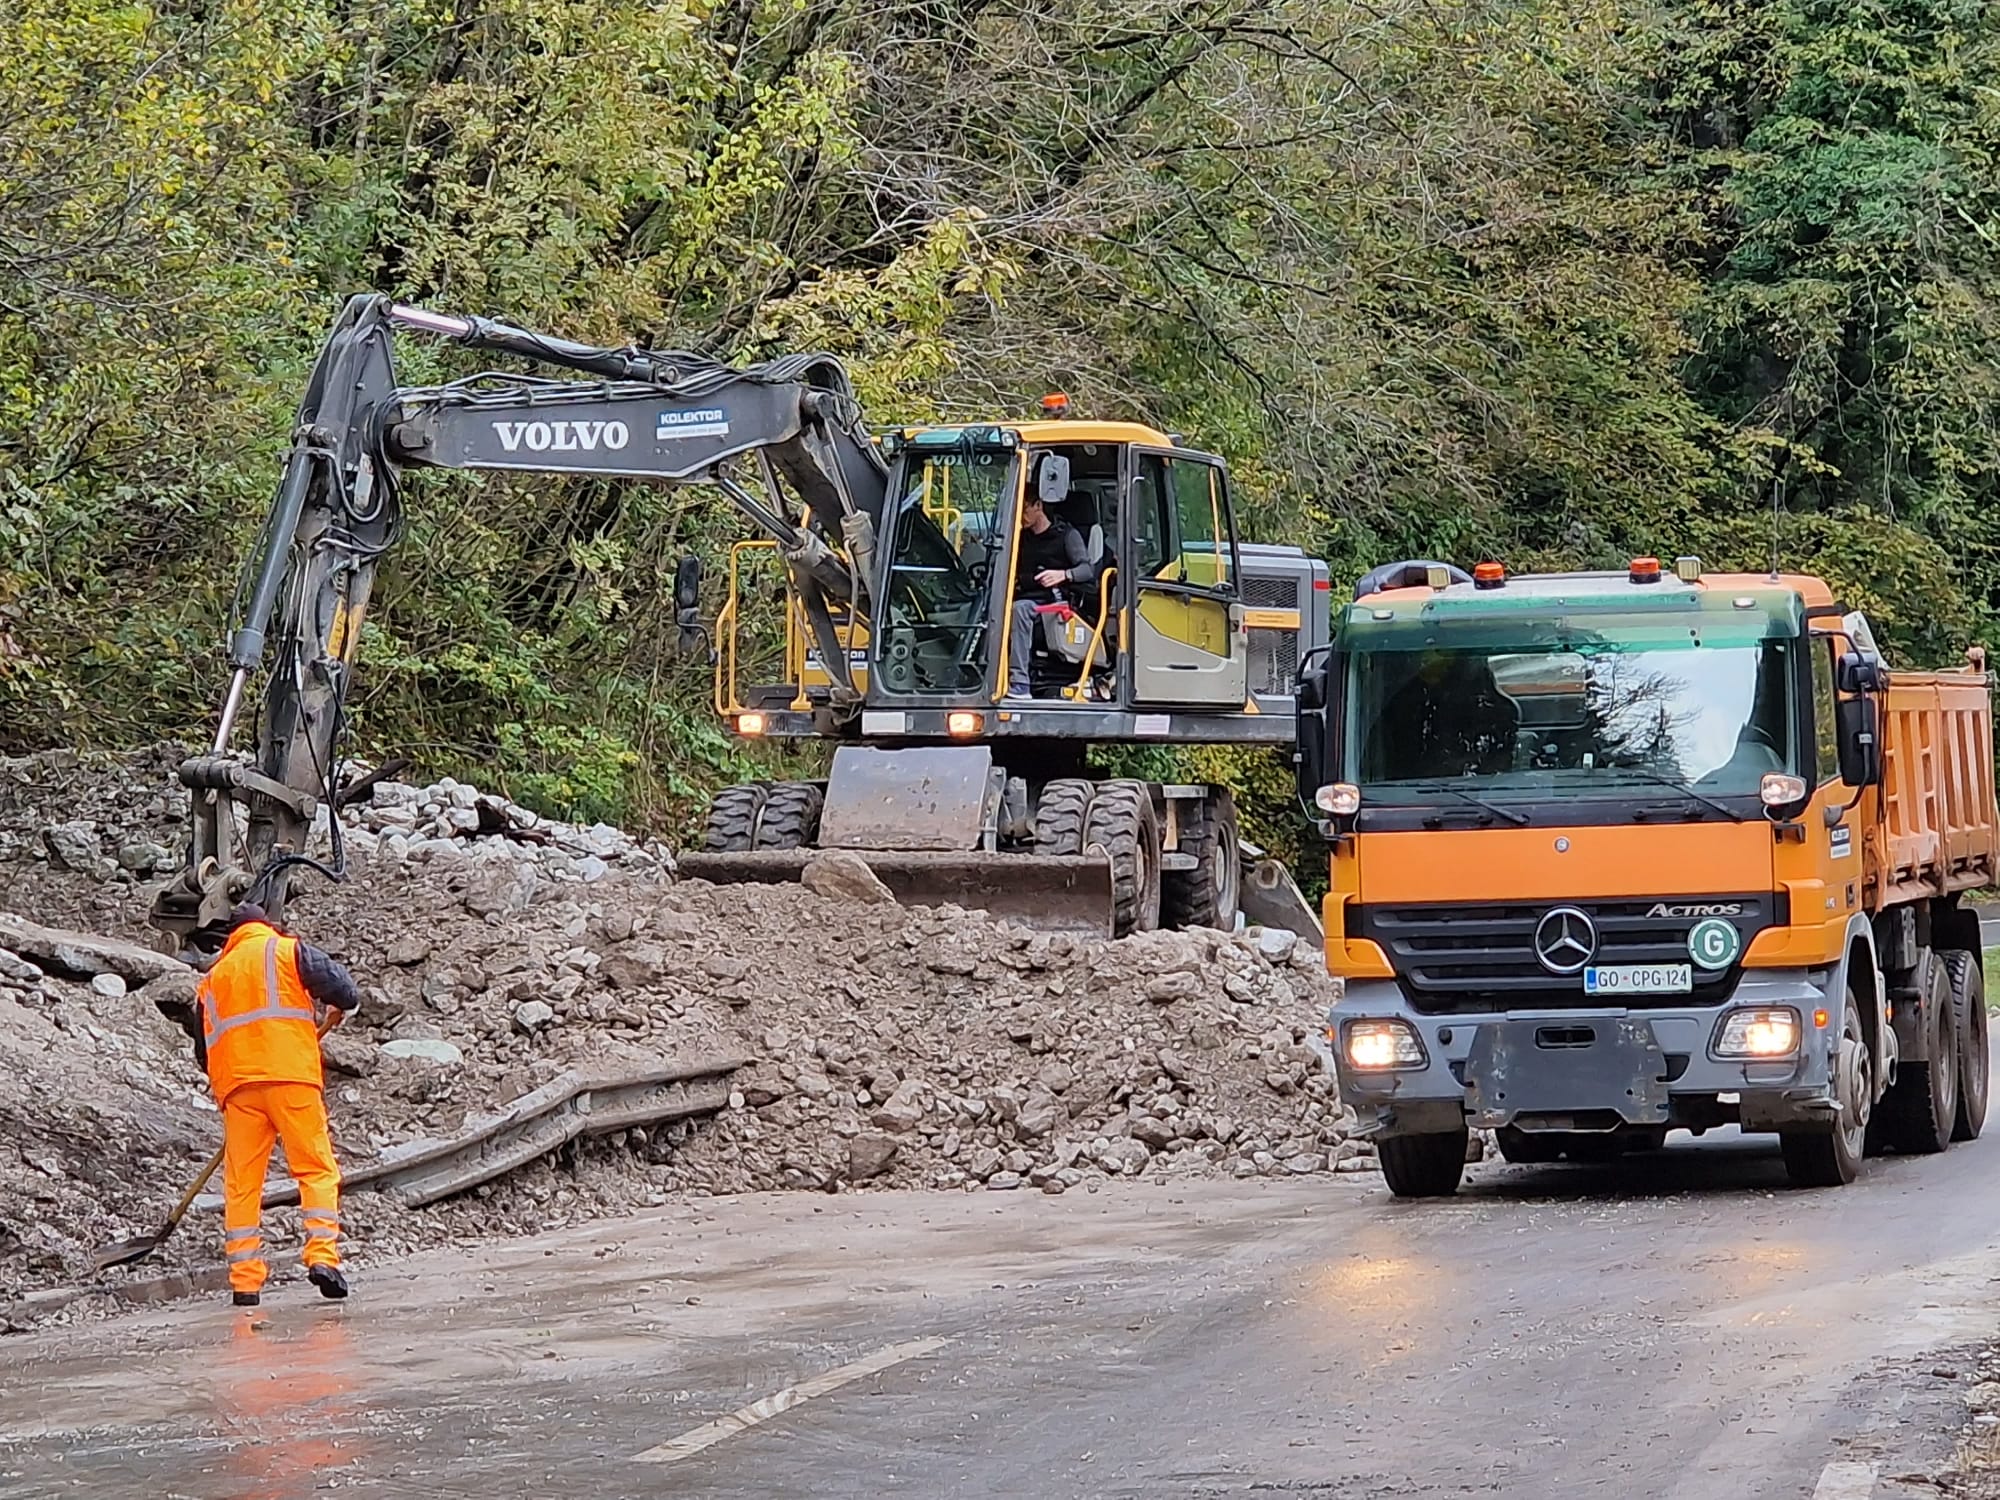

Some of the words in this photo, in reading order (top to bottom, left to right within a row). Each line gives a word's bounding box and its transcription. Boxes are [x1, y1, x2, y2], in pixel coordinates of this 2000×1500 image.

[660, 409, 723, 425] KOLEKTOR
[491, 421, 630, 451] VOLVO
[1704, 929, 1725, 957] G
[1598, 971, 1619, 987] GO
